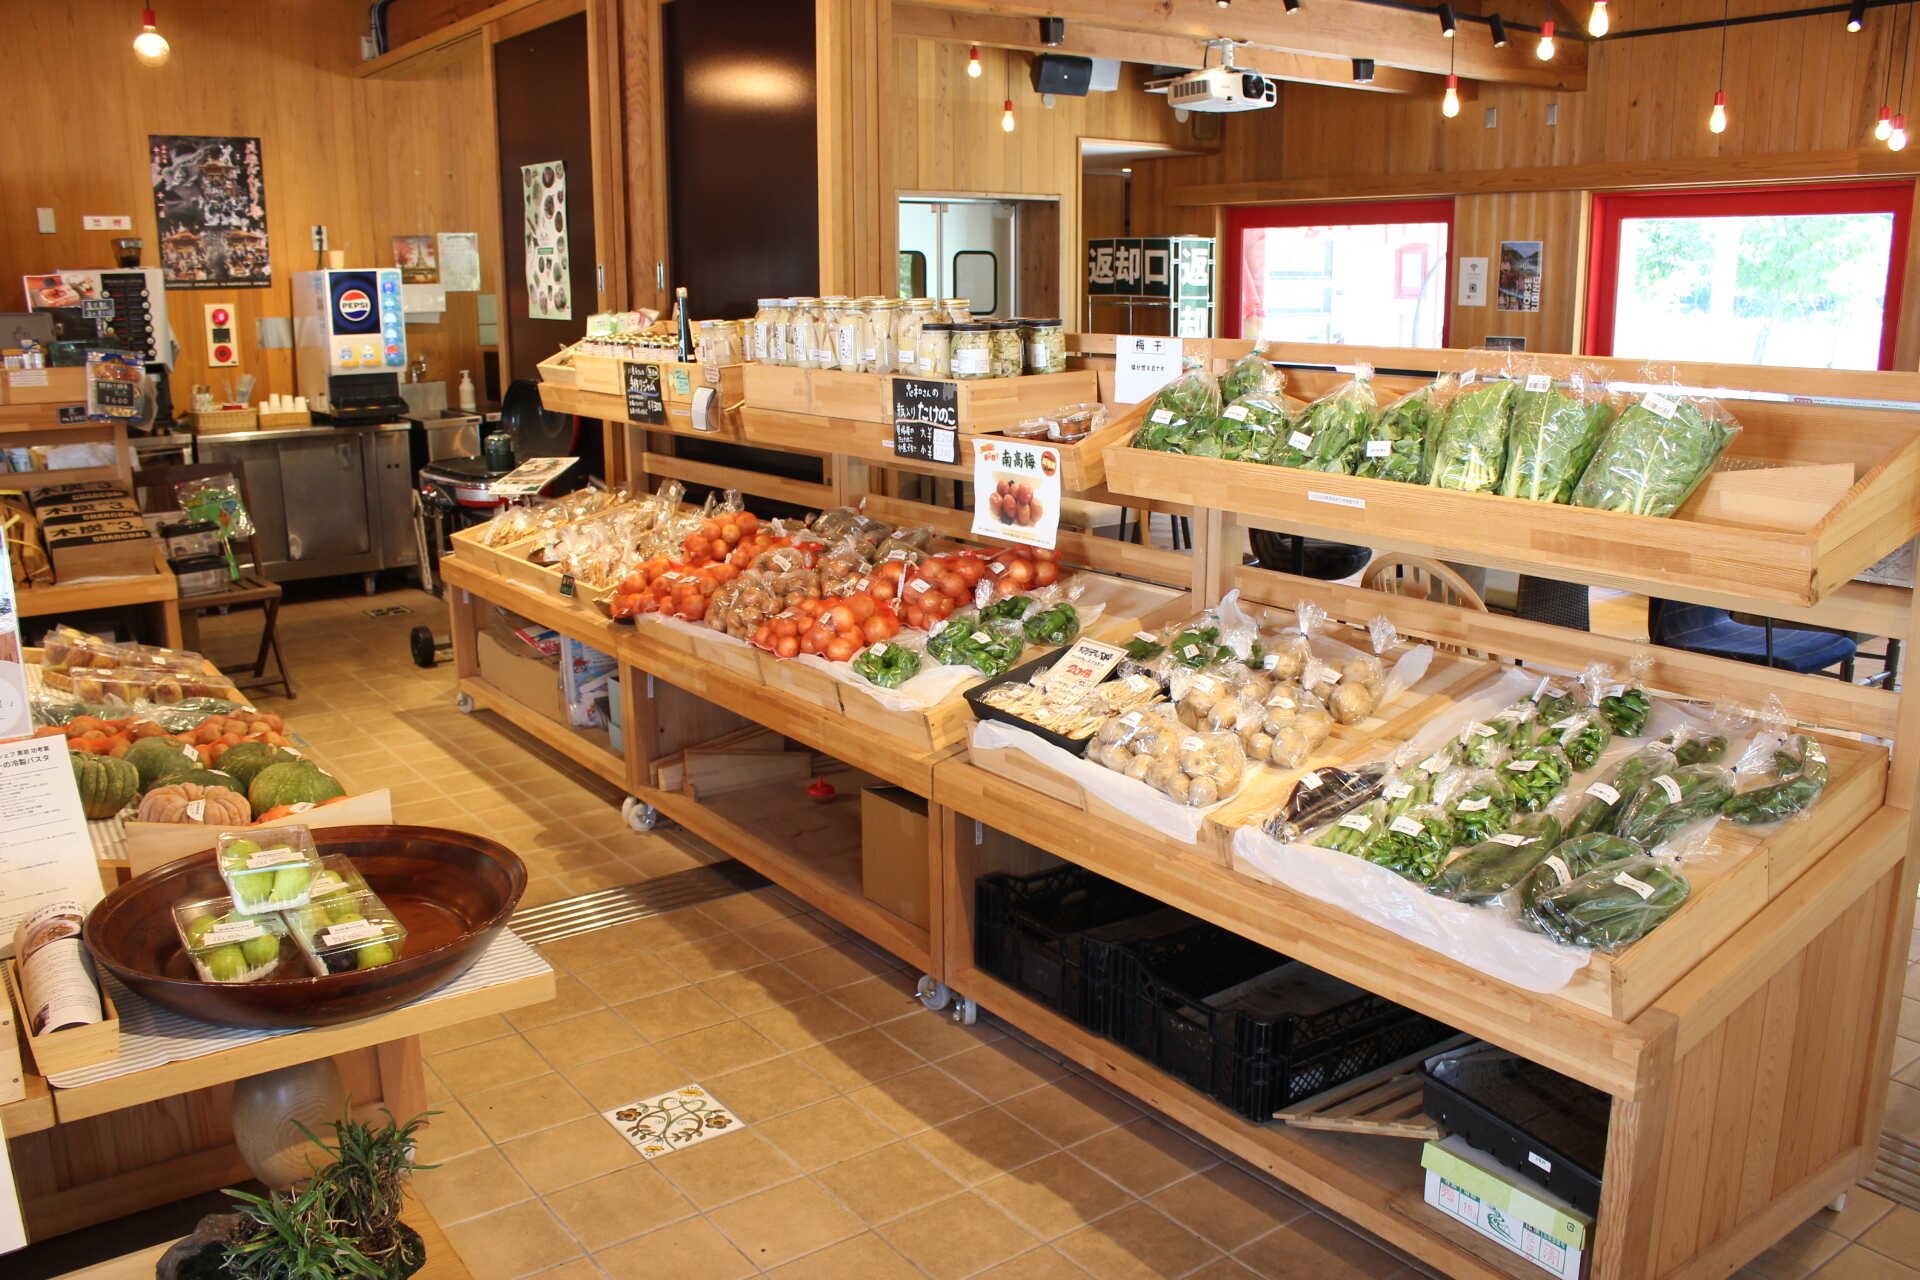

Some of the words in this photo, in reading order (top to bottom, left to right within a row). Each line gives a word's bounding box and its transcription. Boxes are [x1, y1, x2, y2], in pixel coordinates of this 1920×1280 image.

[1088, 246, 1169, 285] 返却口
[342, 301, 368, 309] PEPSI
[918, 401, 956, 425] たけのこ
[1001, 449, 1036, 470] 南高梅
[92, 531, 151, 542] CHARCOAL
